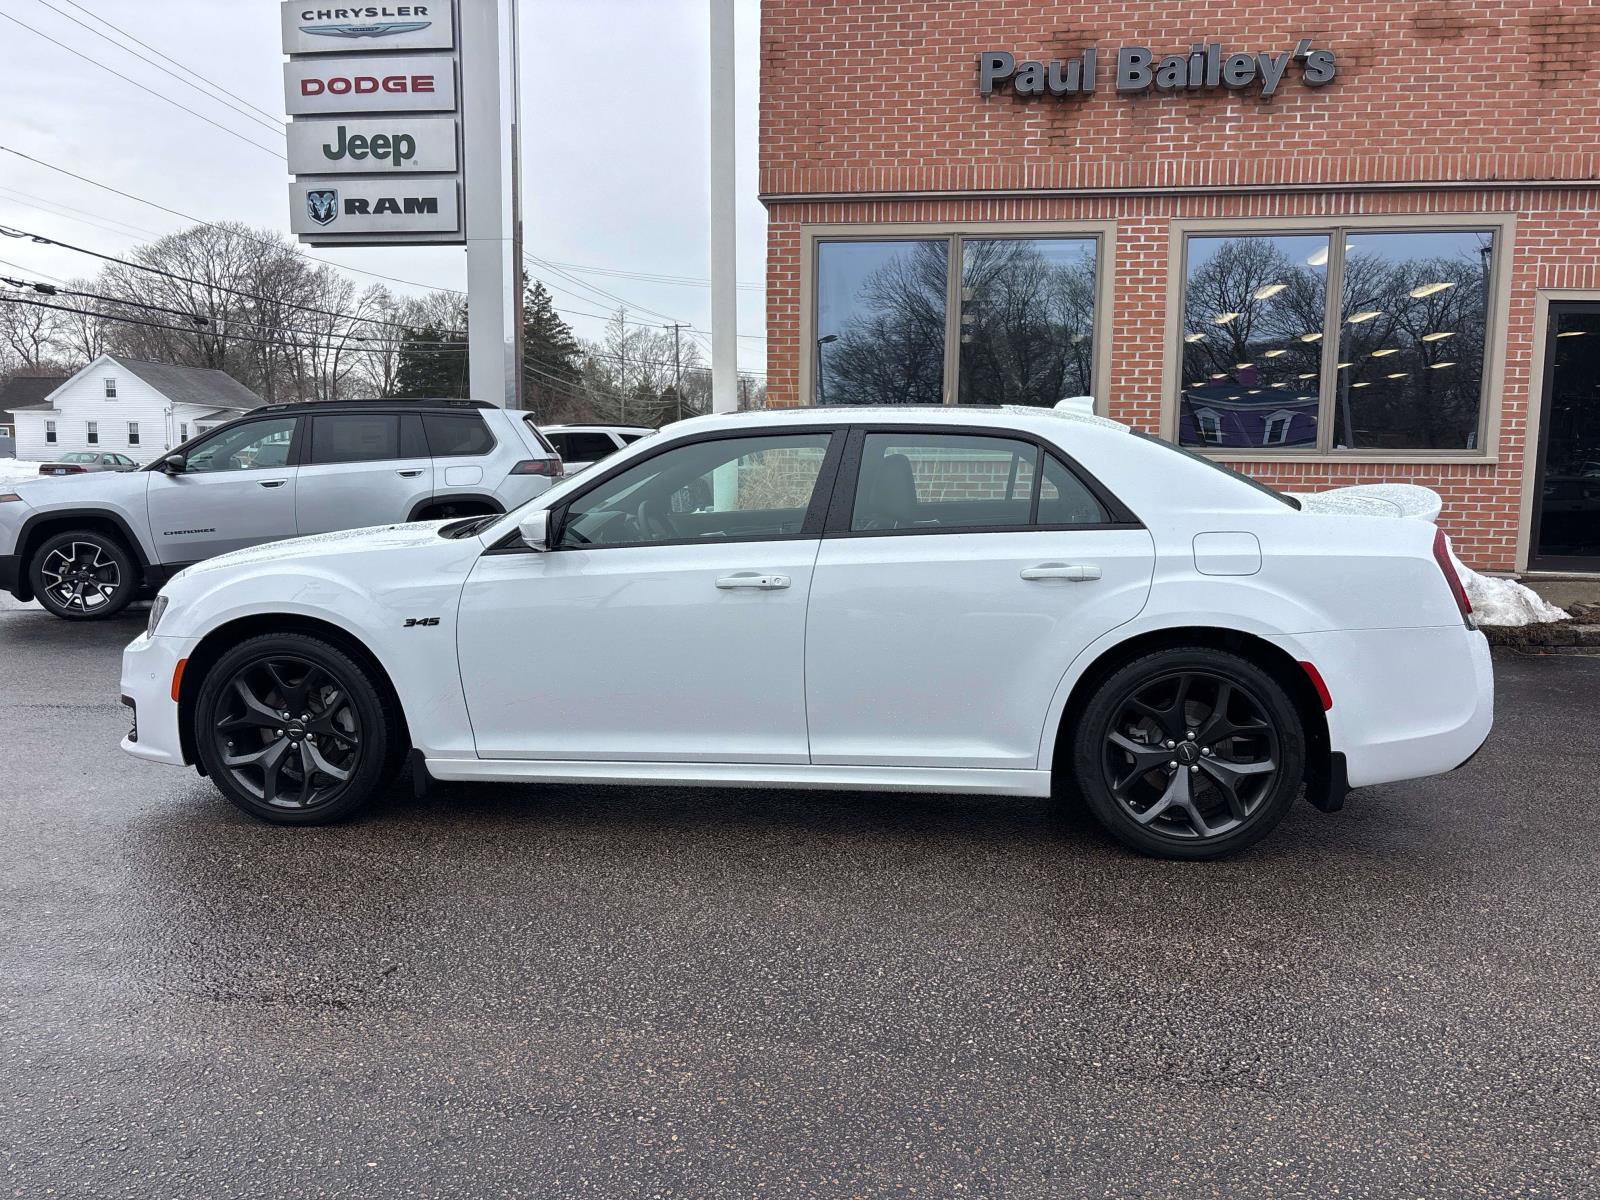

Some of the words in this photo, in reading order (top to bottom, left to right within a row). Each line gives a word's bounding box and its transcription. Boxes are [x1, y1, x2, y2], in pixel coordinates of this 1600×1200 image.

[301, 6, 428, 21] CHRYSLER
[979, 47, 1097, 96] Paul
[1116, 39, 1336, 97] Bailey's
[300, 75, 435, 96] DODGE
[322, 125, 416, 167] Jeep
[344, 197, 438, 215] RAM
[163, 527, 216, 536] CHEROKEE
[403, 617, 440, 627] 345
